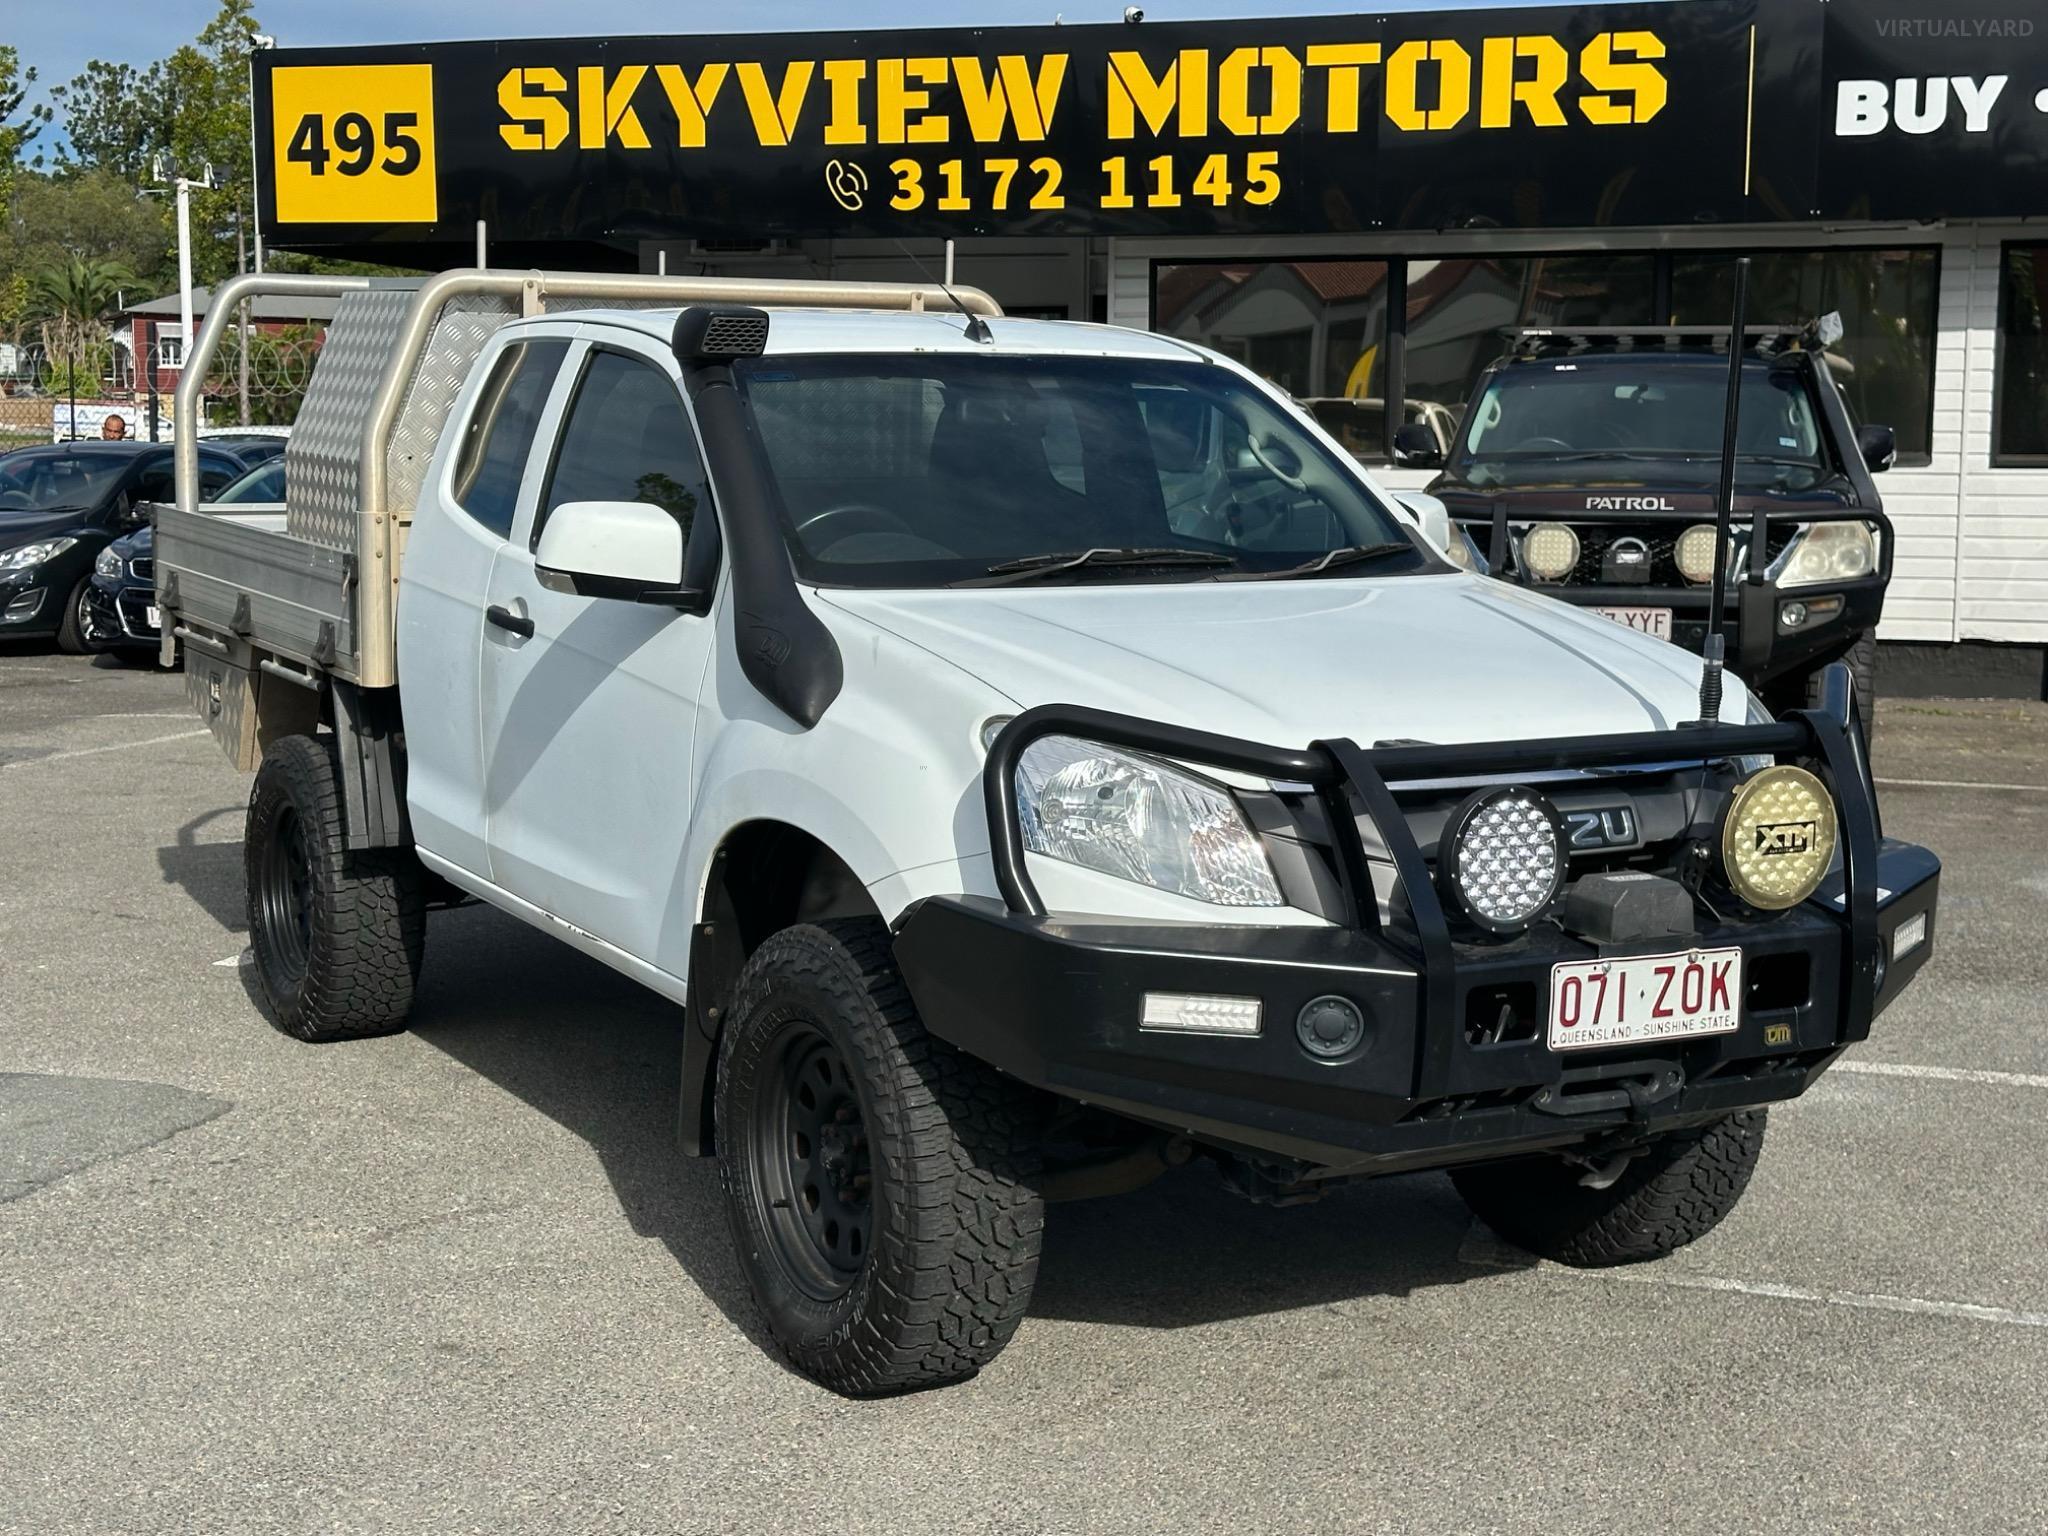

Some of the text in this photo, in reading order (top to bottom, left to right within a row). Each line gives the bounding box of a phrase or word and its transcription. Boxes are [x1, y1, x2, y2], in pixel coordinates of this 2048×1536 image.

[497, 31, 1669, 151] SKYVIEW MOTORS
[1835, 75, 2009, 137] BUY
[287, 112, 422, 177] 495
[889, 151, 1283, 211] 3172 1145
[1586, 497, 1675, 511] PATROL
[1559, 960, 1733, 1028] 071 ZOK
[1559, 1025, 1632, 1044] QUEENSLAND
[1643, 1018, 1695, 1036] SUNSHINE
[1699, 1014, 1731, 1030] STATE
